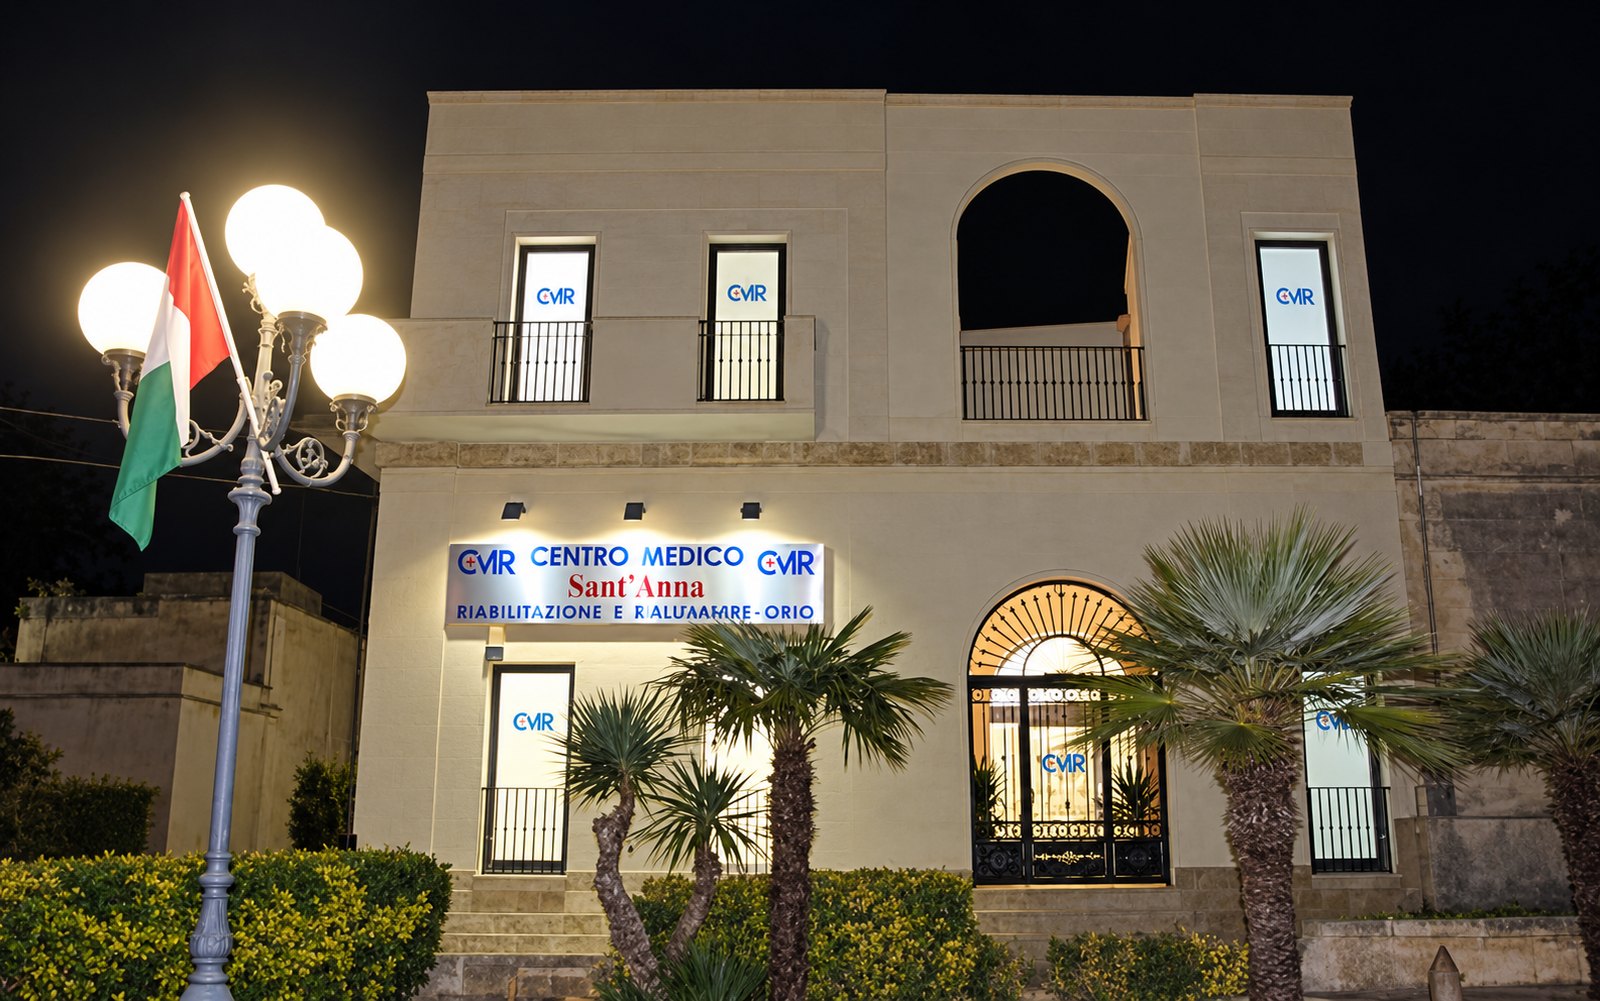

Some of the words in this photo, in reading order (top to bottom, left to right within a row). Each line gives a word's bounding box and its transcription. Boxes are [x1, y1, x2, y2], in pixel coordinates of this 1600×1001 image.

[537, 288, 575, 305] CMR
[728, 285, 766, 302] CMR
[1276, 288, 1314, 305] CMR
[458, 548, 515, 575] CMR
[531, 546, 629, 566] CENTRO
[642, 546, 744, 566] MEDICO
[757, 549, 815, 575] CMR
[569, 574, 703, 597] Sant'Anna
[458, 605, 600, 619] RIABILITAZIONE
[614, 605, 622, 619] E
[513, 712, 555, 731] CMR
[1316, 712, 1350, 731] CM
[1042, 754, 1085, 773] CMR
